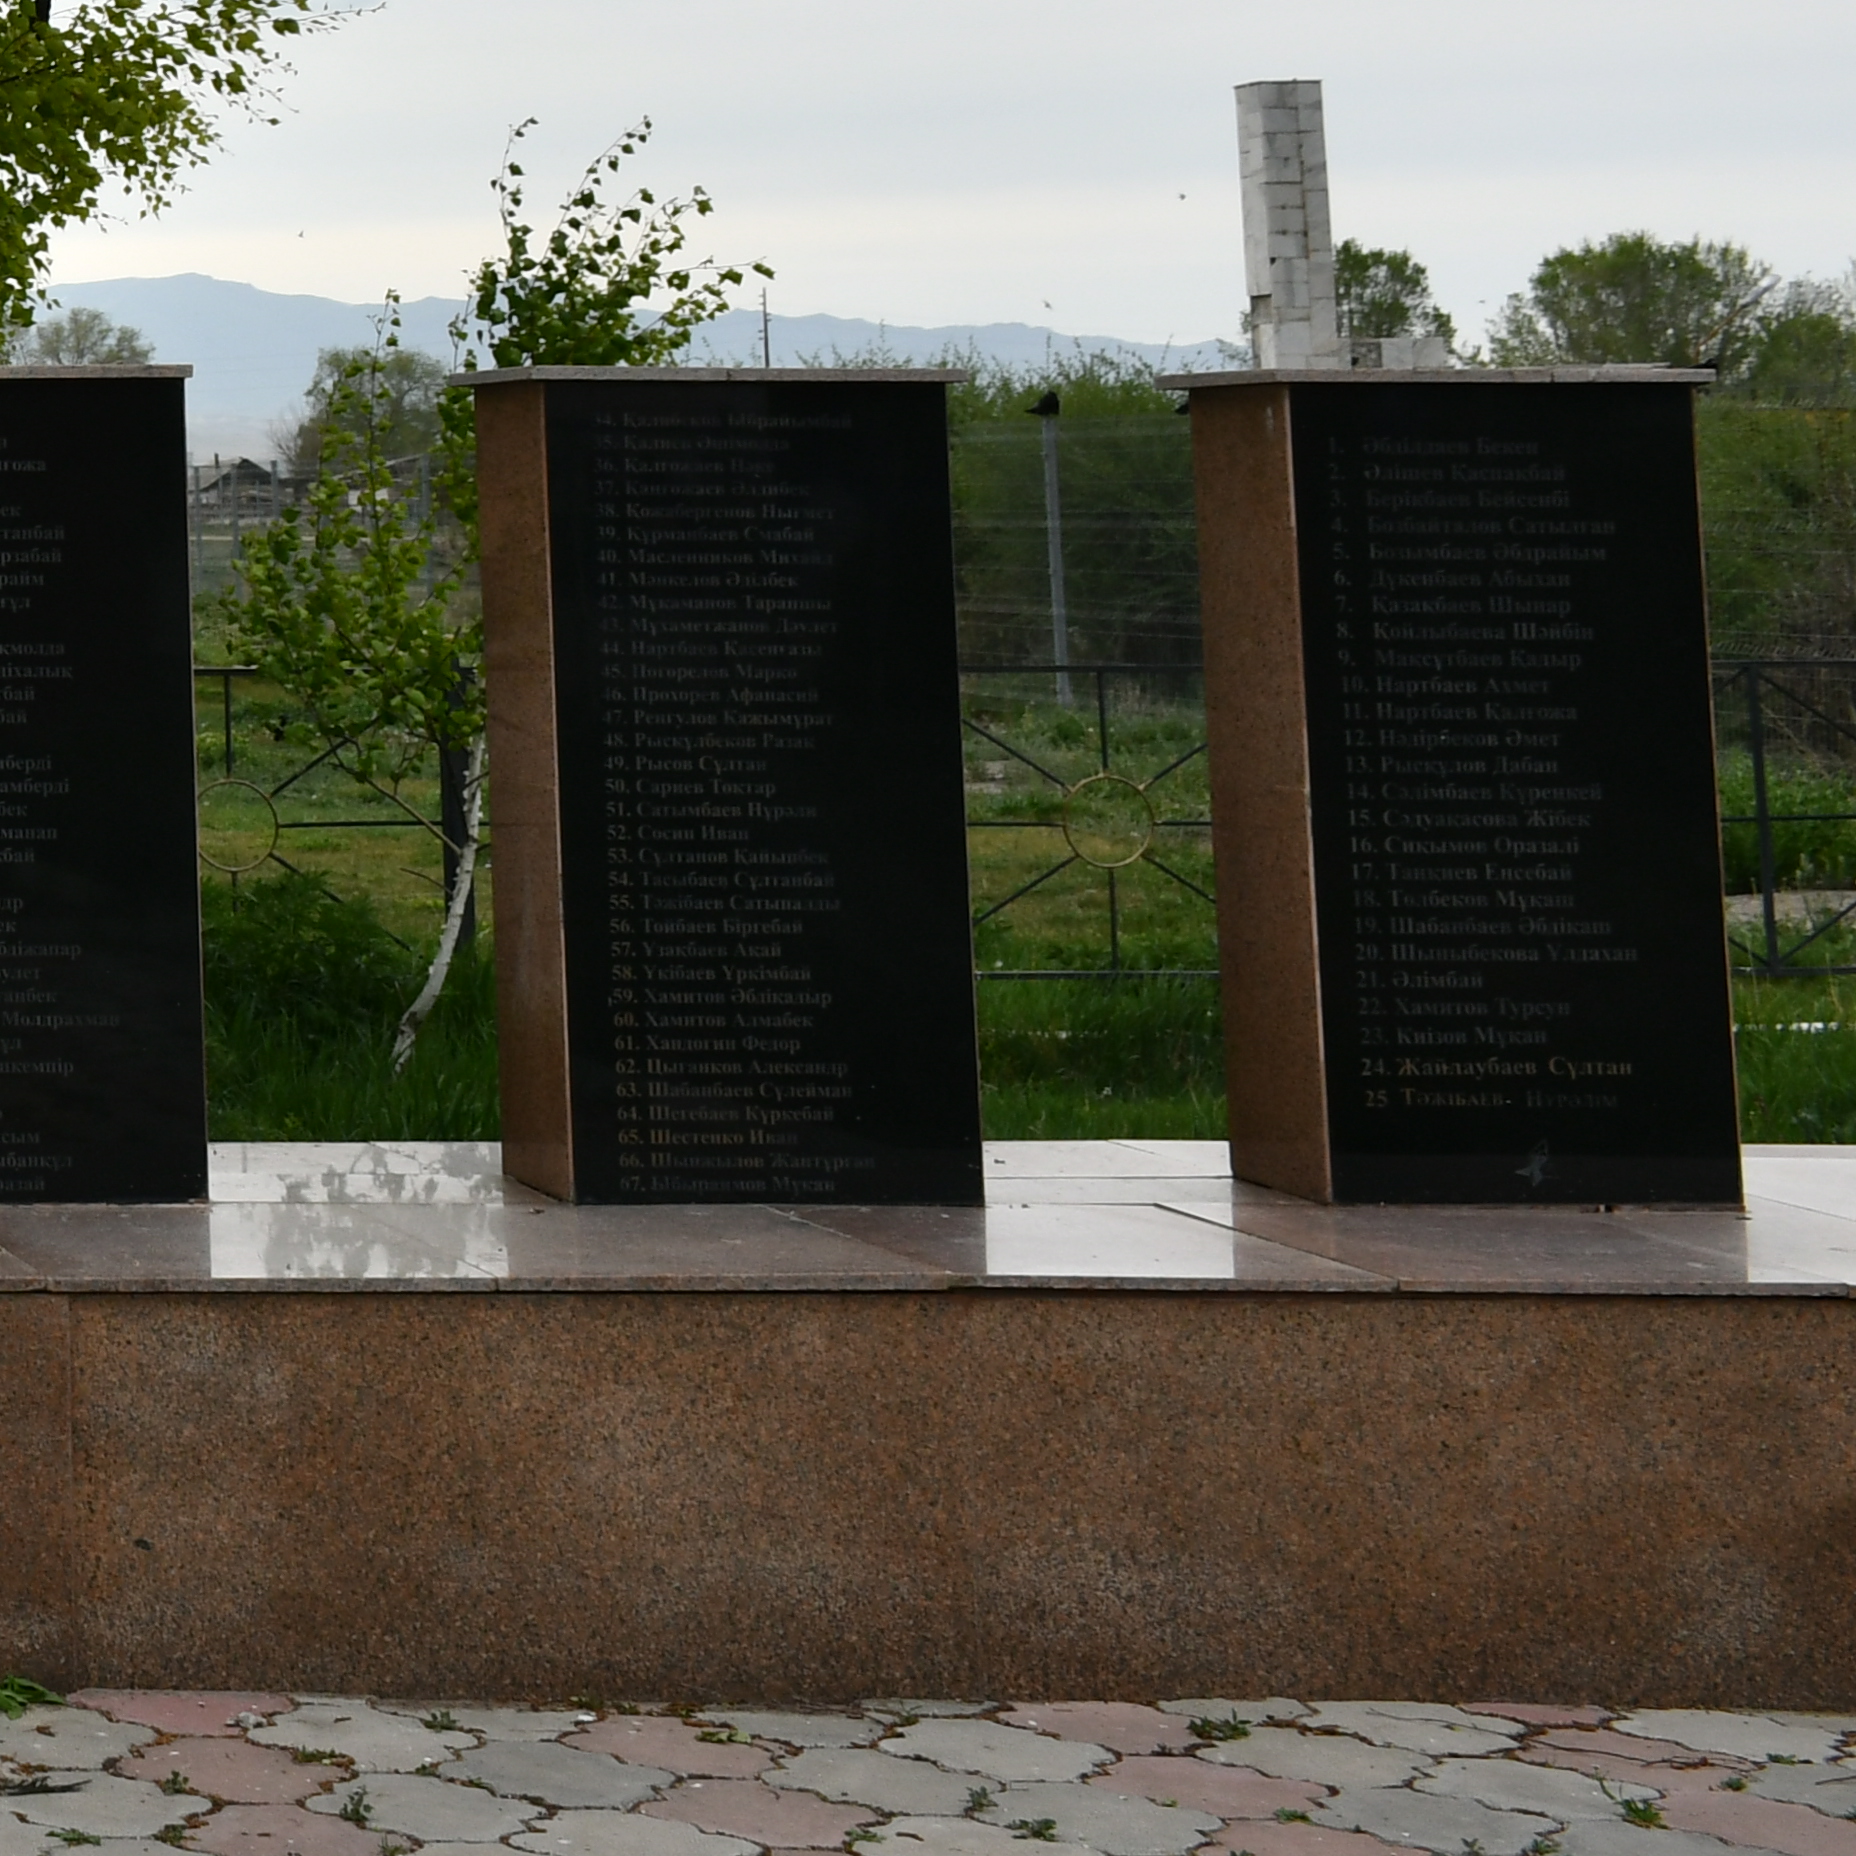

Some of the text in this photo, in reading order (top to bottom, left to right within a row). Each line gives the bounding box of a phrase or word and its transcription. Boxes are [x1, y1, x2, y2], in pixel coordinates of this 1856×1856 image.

[1330, 490, 1347, 507] 3.
[1333, 570, 1352, 586] 6.
[1341, 676, 1369, 693] 10.
[607, 825, 631, 840] 52.
[609, 918, 635, 933] 56.
[611, 965, 637, 980] 58.
[1356, 972, 1385, 988] 21.
[1358, 998, 1387, 1015] 22.
[613, 1012, 640, 1027] 60.
[614, 1035, 640, 1050] 61.
[615, 1059, 641, 1074] 62.
[1361, 1060, 1390, 1076] 24.
[616, 1082, 642, 1097] 63.
